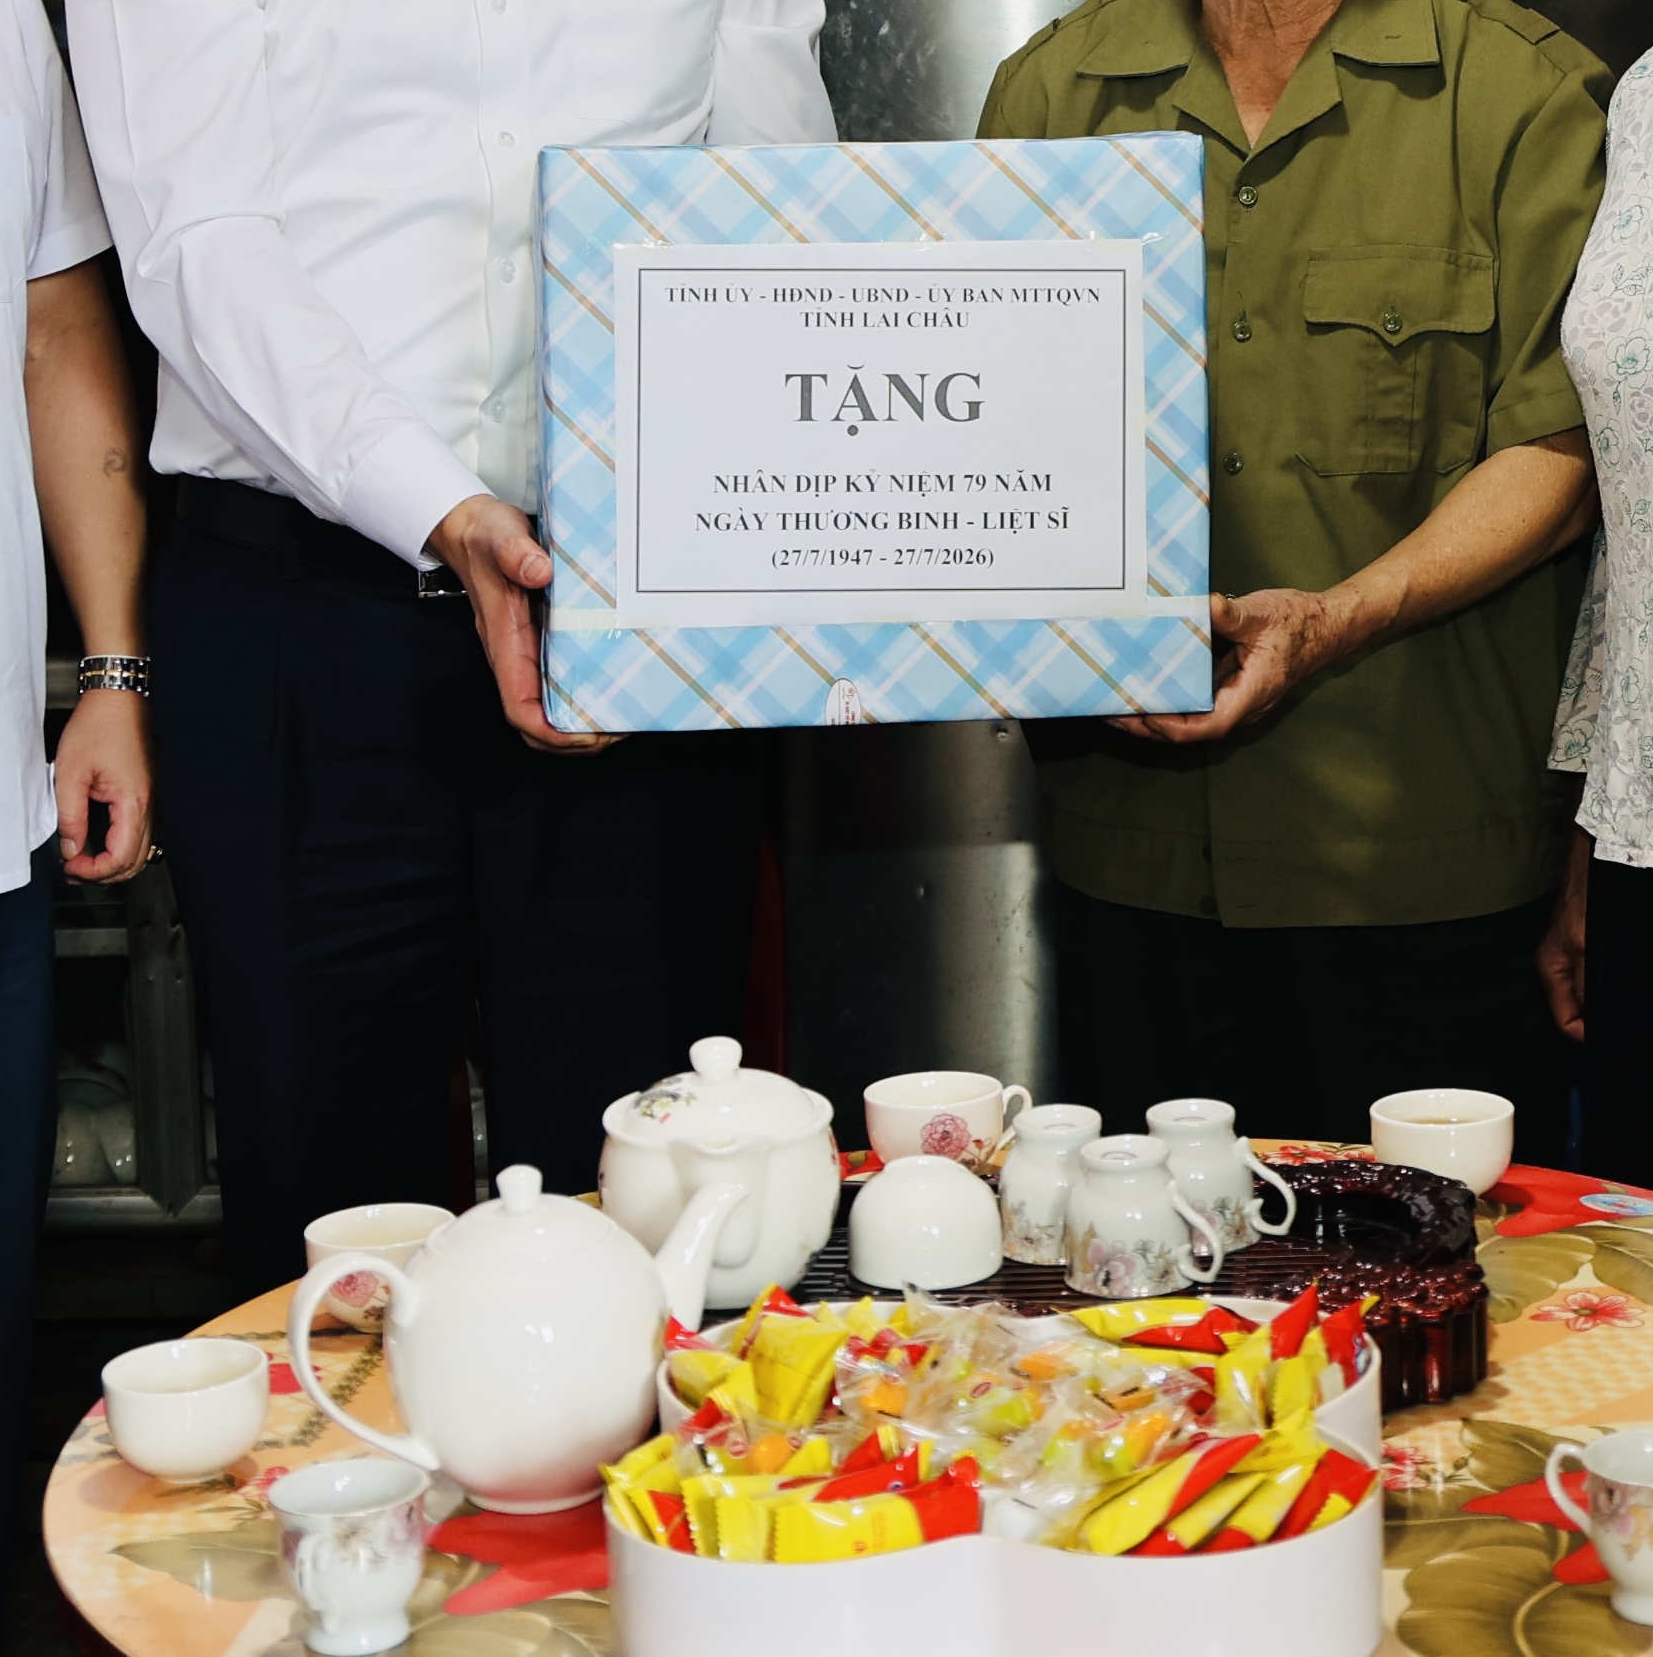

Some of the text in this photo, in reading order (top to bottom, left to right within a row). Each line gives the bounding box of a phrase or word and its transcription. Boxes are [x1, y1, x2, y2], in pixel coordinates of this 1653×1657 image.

[665, 282, 718, 303] TỈNH
[725, 282, 754, 303] ỦY
[773, 287, 833, 303] HĐND
[851, 287, 910, 303] UBND
[928, 283, 956, 303] ỦY
[962, 287, 1004, 303] BAN
[1010, 287, 1101, 306] MTTQVN
[799, 306, 970, 328] TỈNH LAI CHÂU
[784, 364, 986, 437] TẶNG
[713, 468, 1052, 498] NHÂN DỊP KỶ NIỆM 79 NĂM
[695, 506, 769, 532] NGÀY
[775, 509, 889, 531] THƯƠNG
[897, 511, 959, 530] BINH
[982, 508, 1041, 535] LIỆT
[1047, 506, 1070, 530] SĨ
[771, 548, 874, 570] (27/7/1947
[893, 547, 996, 569] 27/7/2026)
